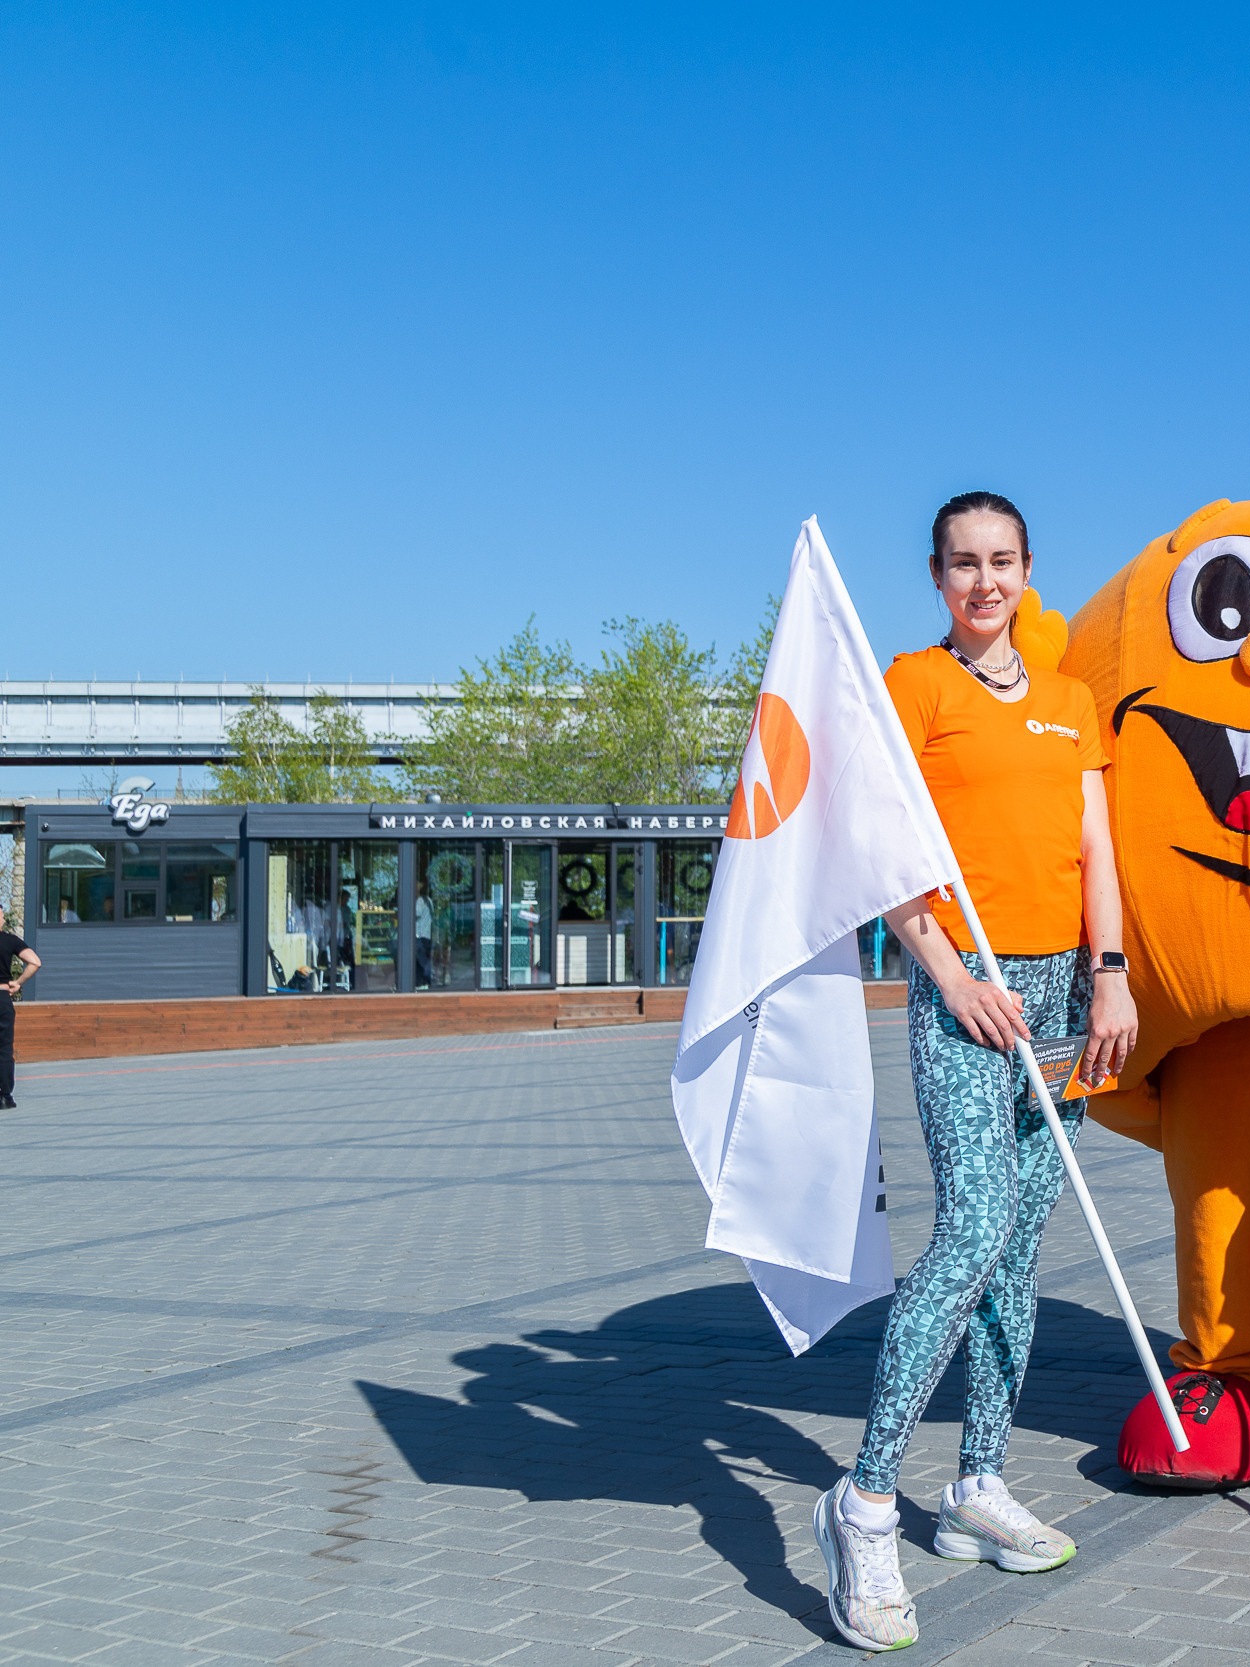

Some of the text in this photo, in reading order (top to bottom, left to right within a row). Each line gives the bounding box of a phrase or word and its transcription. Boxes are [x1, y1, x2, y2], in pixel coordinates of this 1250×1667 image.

[382, 812, 728, 829] МИХАЙЛОВСКАЯ НАБЕРЕ
[1037, 1052, 1075, 1064] ЕРТИФИКАТ
